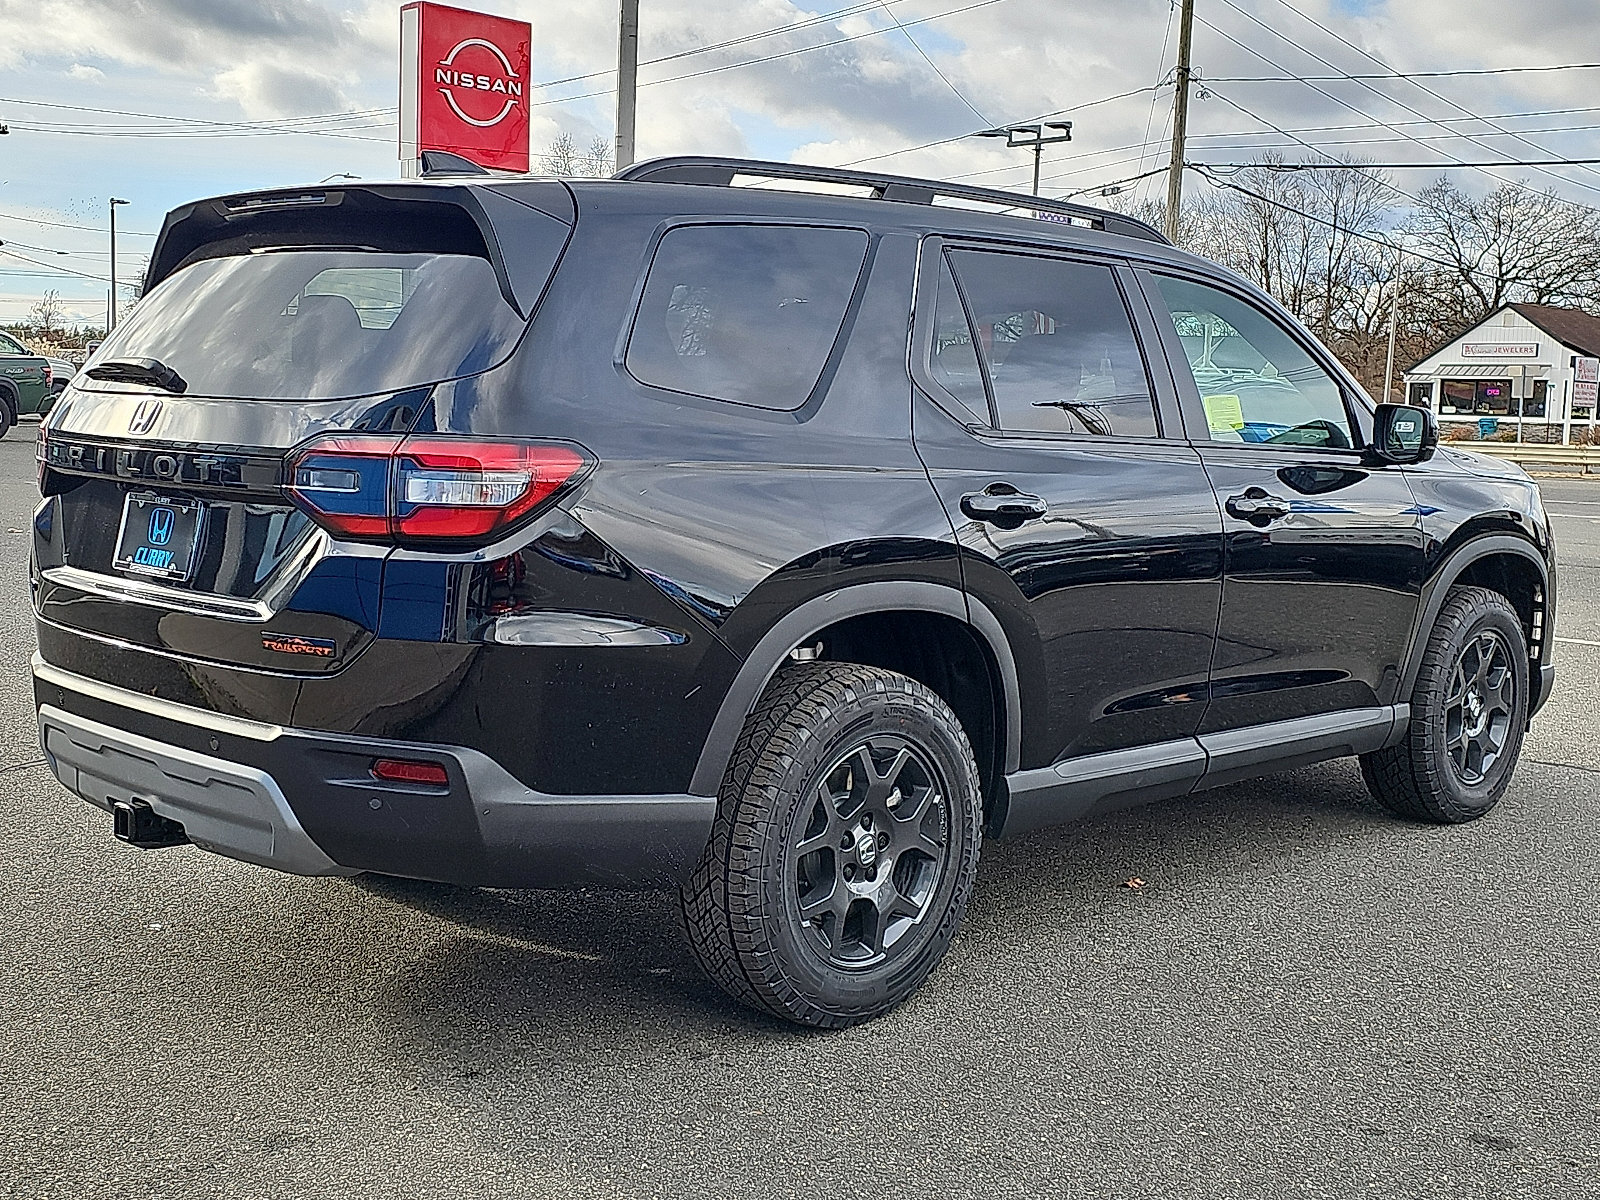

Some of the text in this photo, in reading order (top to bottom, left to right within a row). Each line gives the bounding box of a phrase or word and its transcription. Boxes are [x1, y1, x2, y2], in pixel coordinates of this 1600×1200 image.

[435, 68, 522, 96] NISSAN
[1493, 346, 1535, 354] JEWELERS
[66, 445, 219, 483] PILOT
[134, 546, 175, 569] CURRY
[262, 640, 333, 656] TRAILSPORT
